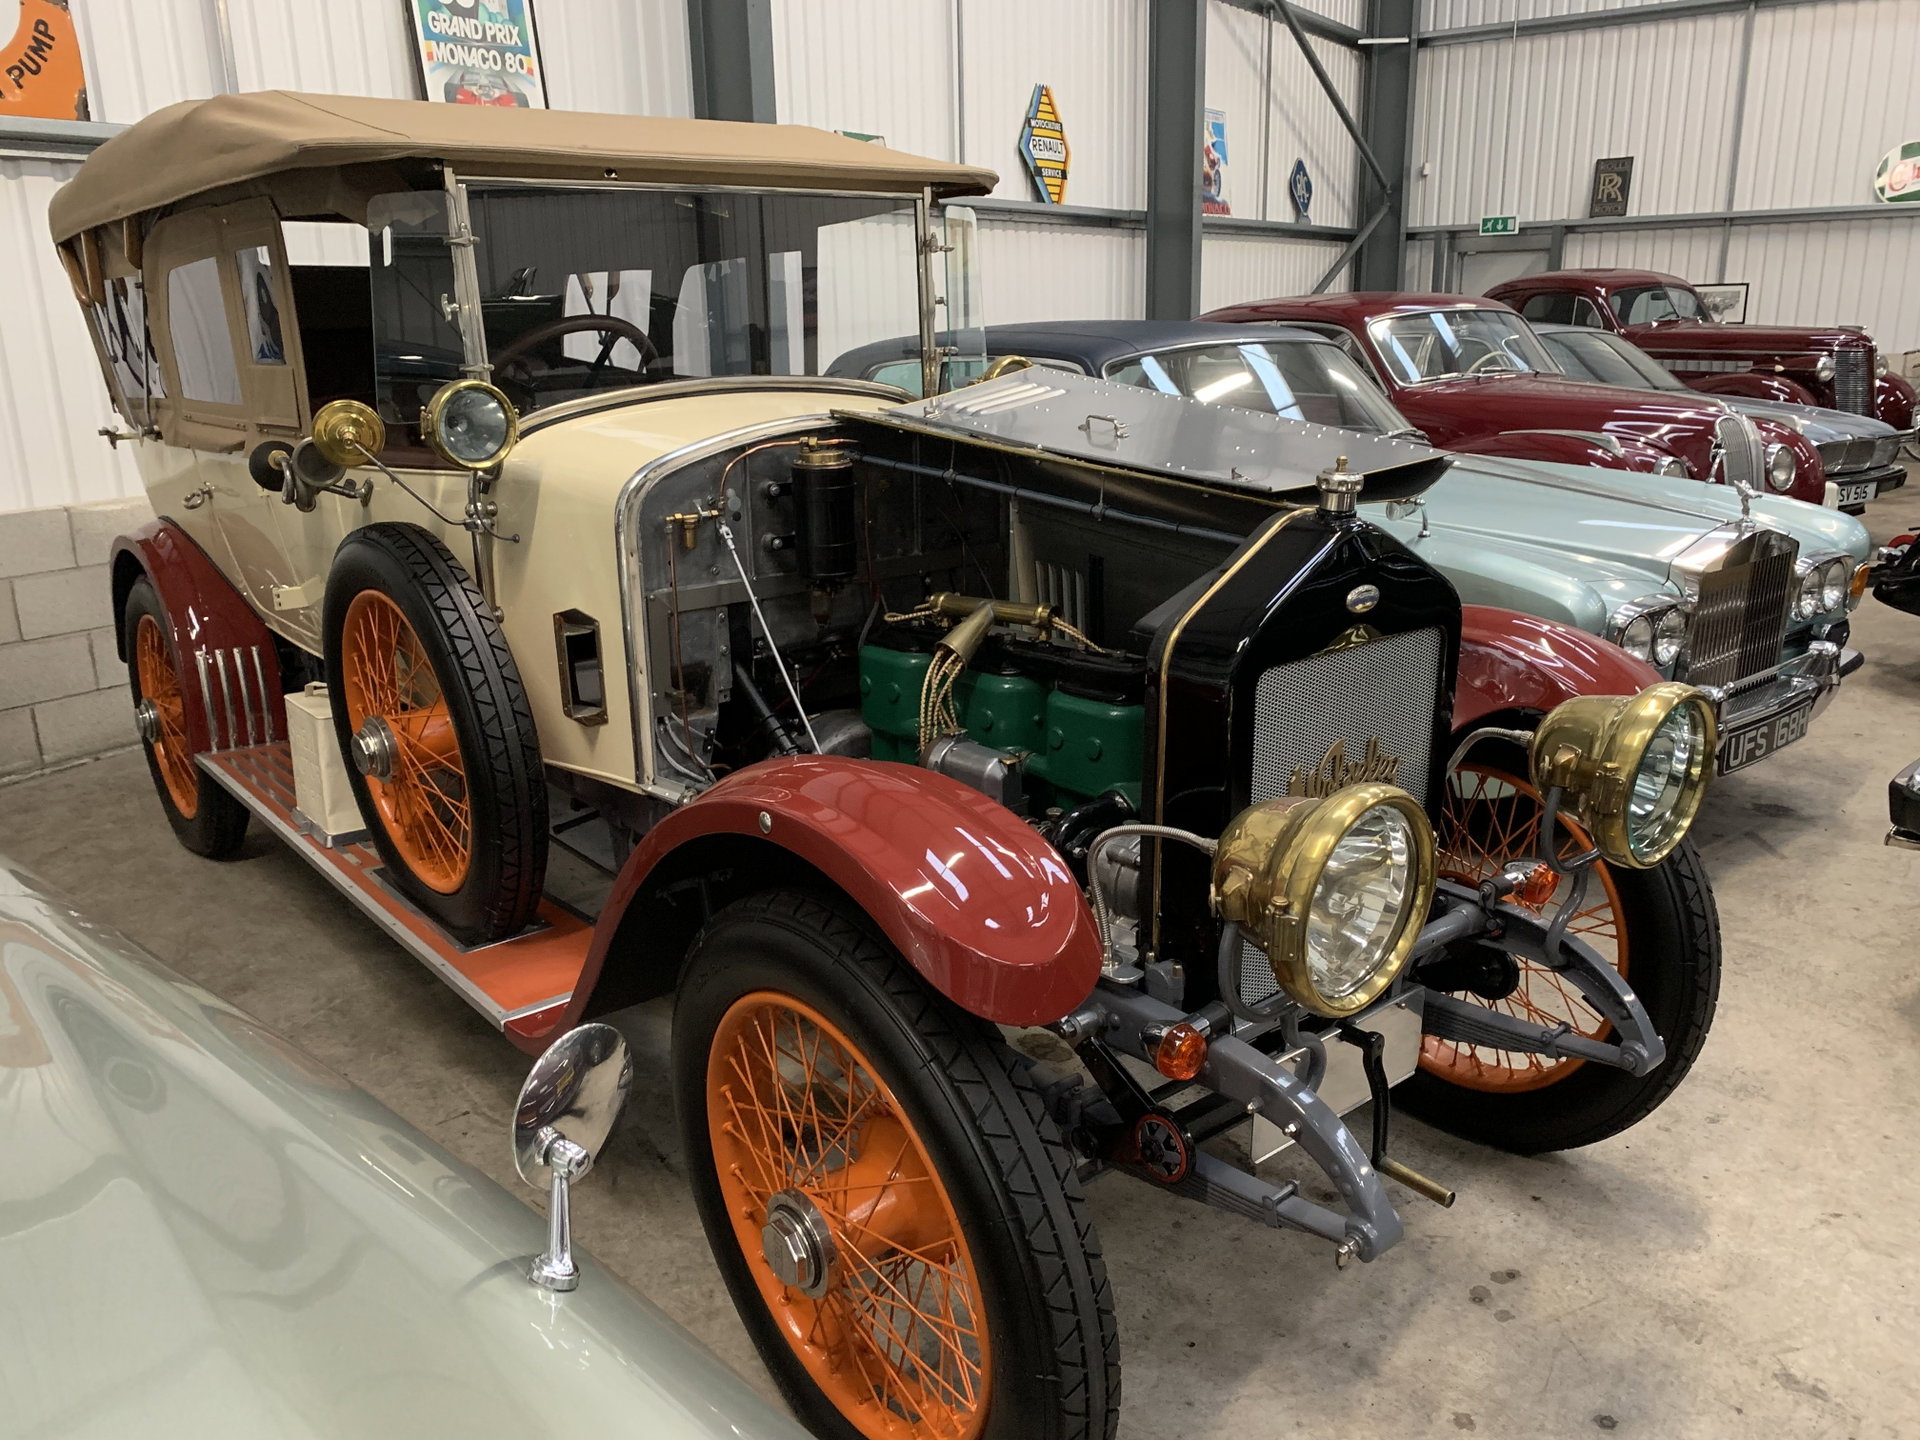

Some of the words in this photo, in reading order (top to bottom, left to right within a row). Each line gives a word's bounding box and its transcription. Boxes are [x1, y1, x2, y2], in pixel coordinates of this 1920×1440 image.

[427, 10, 481, 40] GRAND
[485, 20, 522, 47] PRIX
[5, 18, 56, 90] PUMP
[431, 40, 501, 72] MONACO
[505, 52, 528, 75] 80
[1032, 138, 1064, 155] RENAULT
[1041, 167, 1062, 178] SERVICE
[1853, 485, 1869, 500] 515
[1728, 725, 1768, 767] UFS
[1773, 705, 1809, 749] 168H
